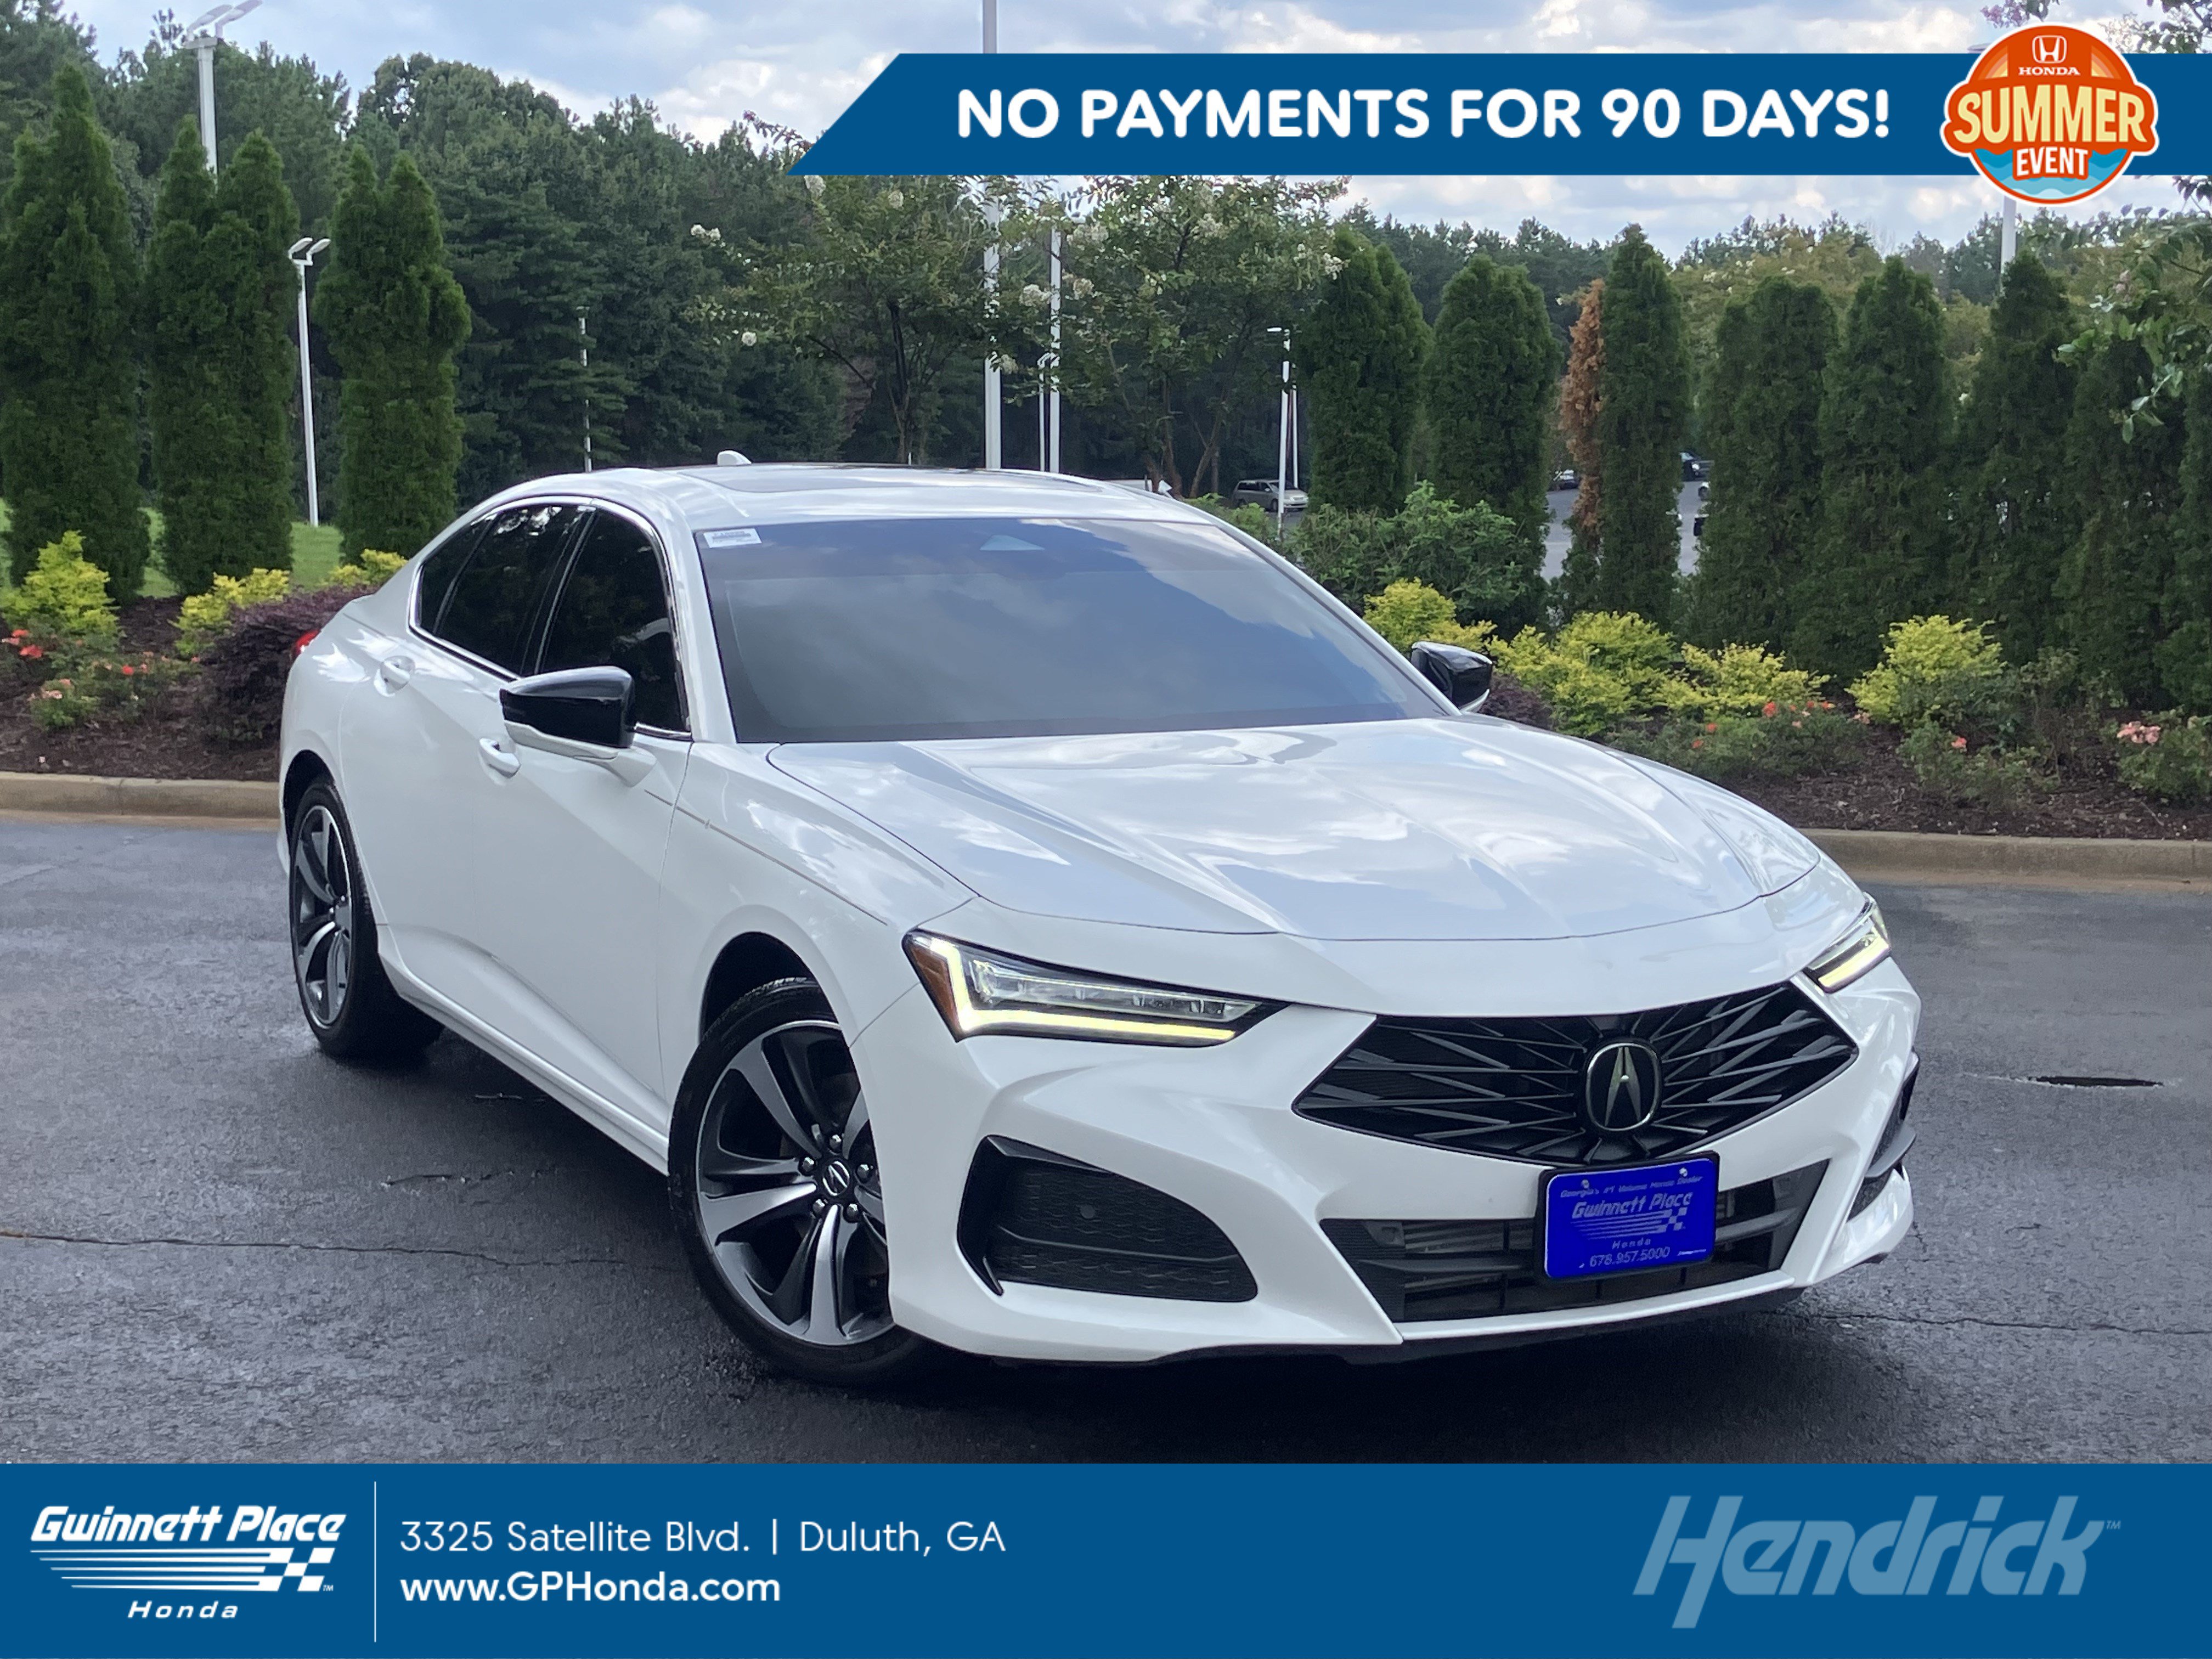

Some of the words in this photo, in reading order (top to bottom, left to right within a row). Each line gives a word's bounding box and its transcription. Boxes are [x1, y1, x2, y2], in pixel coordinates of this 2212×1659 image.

[1572, 1195, 1646, 1219] Gwinnett
[1649, 1192, 1694, 1210] Place
[1612, 1238, 1651, 1250] Honda
[1590, 1246, 1671, 1267] 678.957.5000
